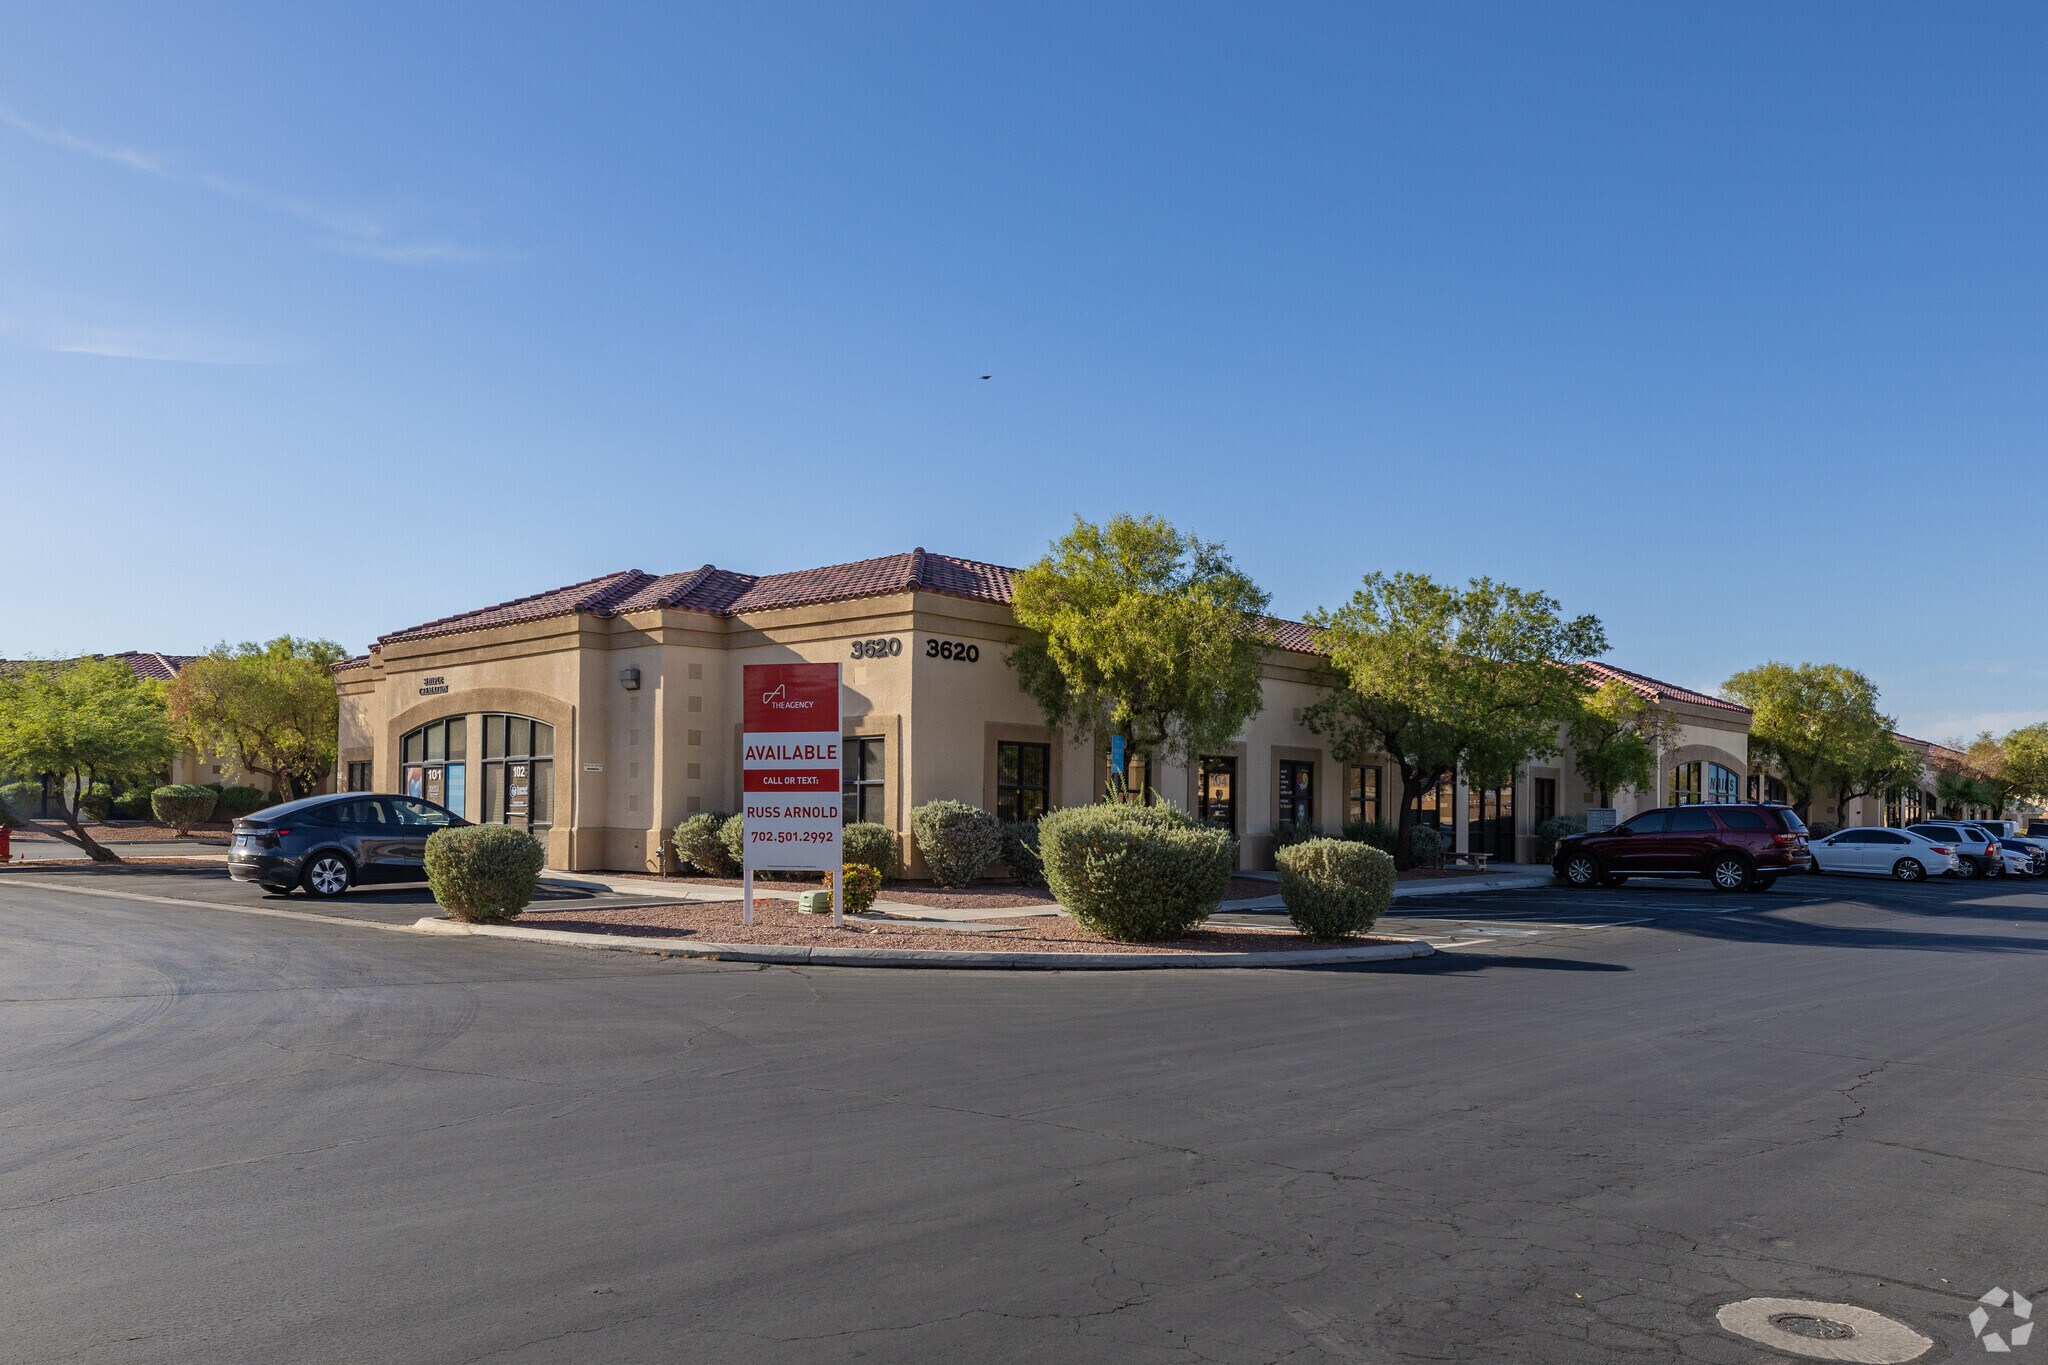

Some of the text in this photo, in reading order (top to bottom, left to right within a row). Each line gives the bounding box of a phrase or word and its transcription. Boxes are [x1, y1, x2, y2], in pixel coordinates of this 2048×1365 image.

[850, 637, 902, 659] 3620
[926, 639, 979, 662] 3620
[745, 745, 837, 760] AVAILABLE
[427, 769, 442, 780] 101
[513, 765, 525, 777] 102
[763, 776, 819, 785] CALL OR TEXT:
[747, 806, 838, 818] RUSS ARNOLD
[751, 831, 834, 844] 702.501.2992
